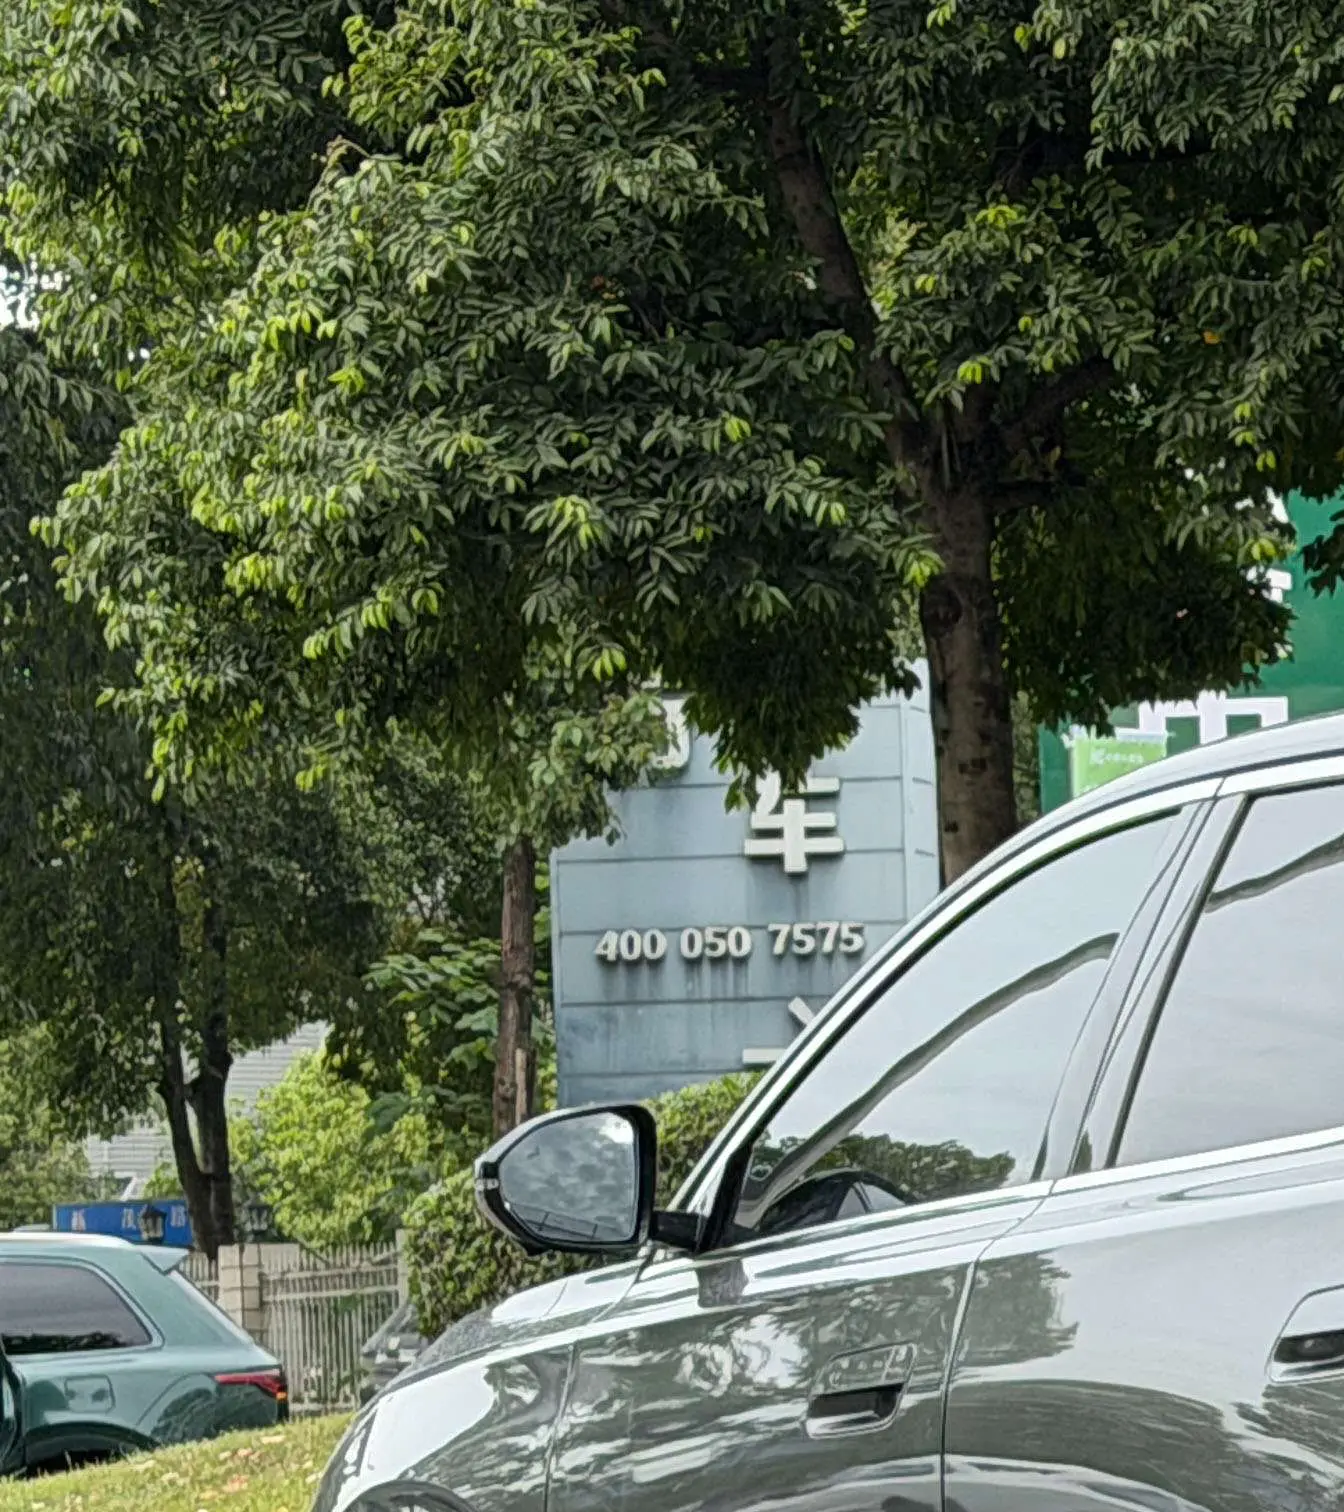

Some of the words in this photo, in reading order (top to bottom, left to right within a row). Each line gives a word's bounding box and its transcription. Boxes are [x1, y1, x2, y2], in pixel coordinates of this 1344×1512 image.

[595, 927, 667, 962] 400
[680, 926, 752, 960] 050
[768, 921, 866, 956] 7575
